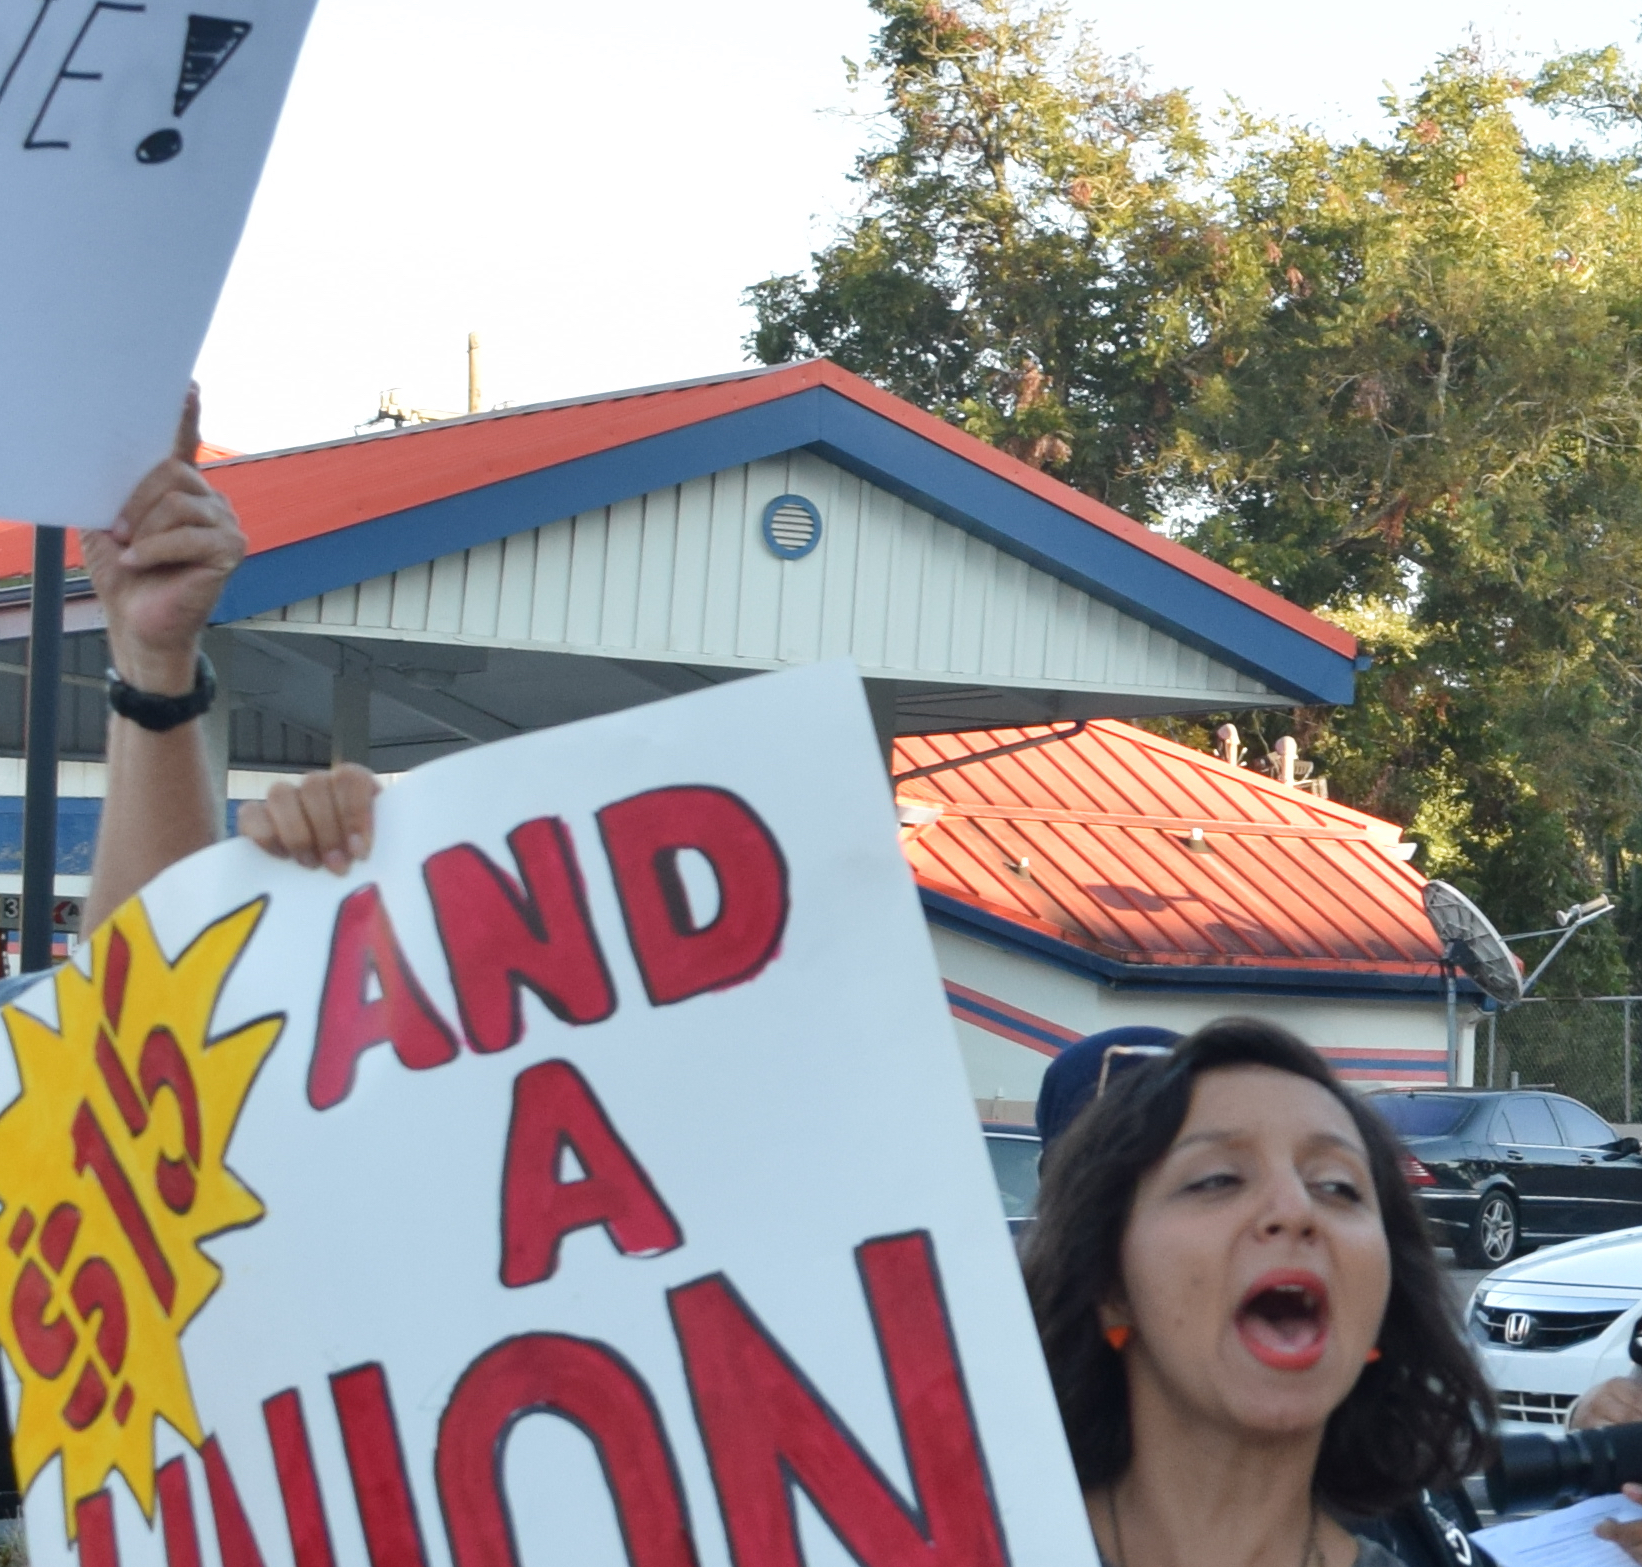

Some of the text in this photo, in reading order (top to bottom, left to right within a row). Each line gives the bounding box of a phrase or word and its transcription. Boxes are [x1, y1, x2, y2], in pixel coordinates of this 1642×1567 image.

[0, 0, 252, 164] E!
[307, 782, 790, 1111] AND
[8, 920, 204, 1434] $15
[497, 1057, 684, 1289] A
